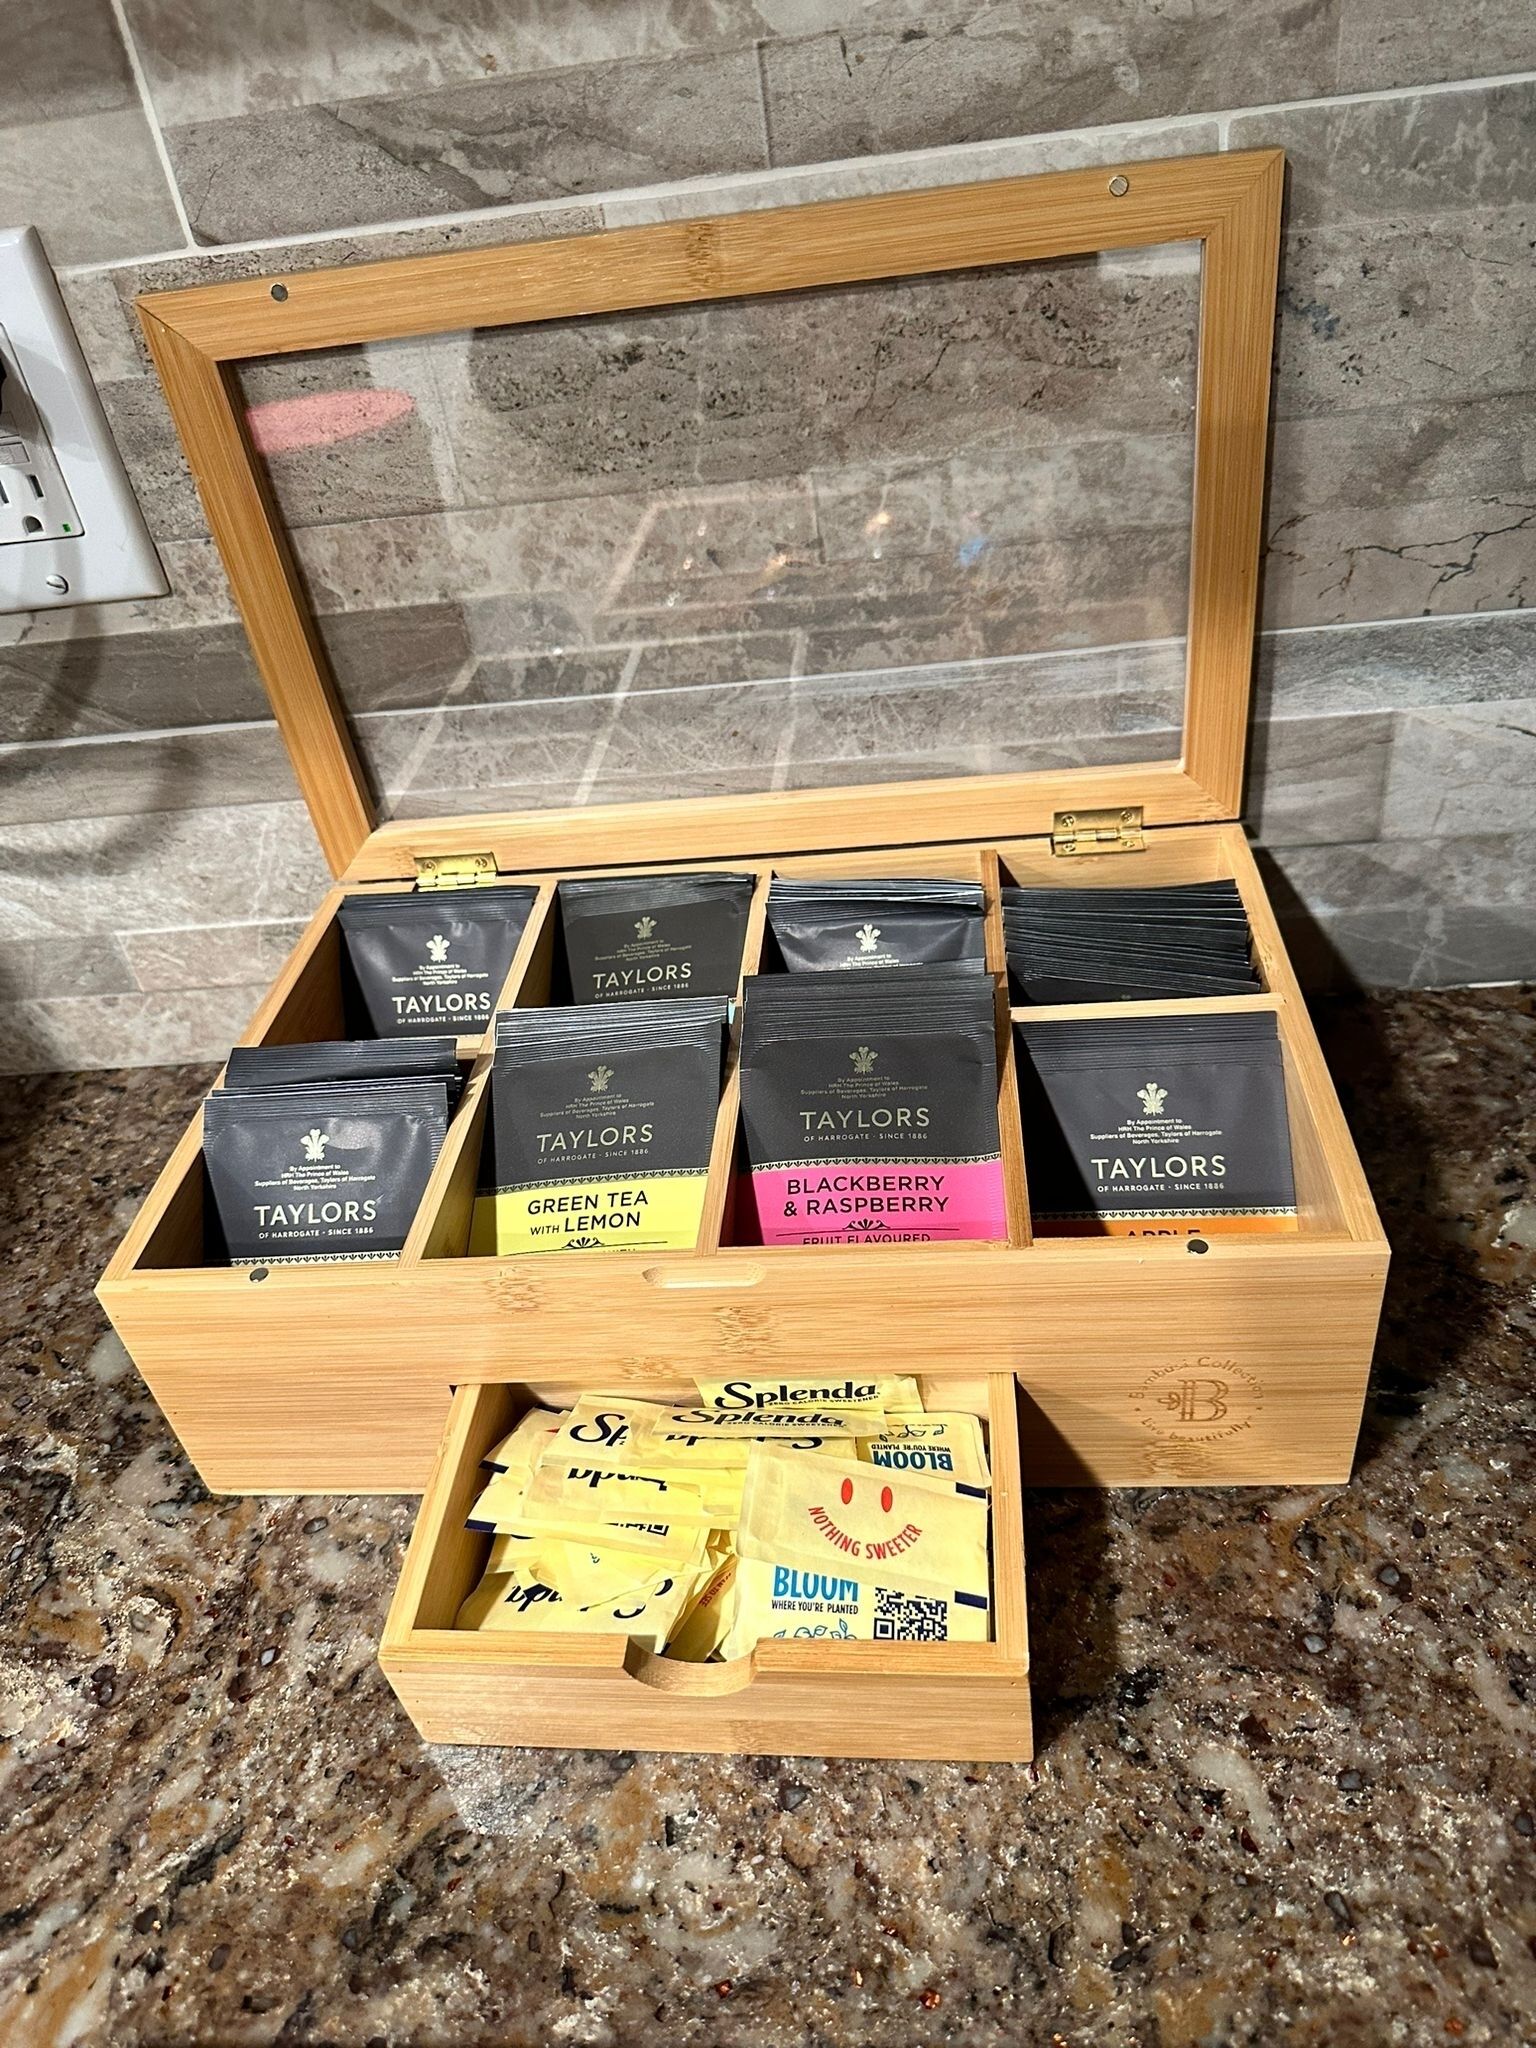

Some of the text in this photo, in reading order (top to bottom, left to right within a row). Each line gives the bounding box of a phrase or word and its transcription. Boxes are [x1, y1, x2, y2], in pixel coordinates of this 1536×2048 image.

[593, 962, 691, 989] TAYLORS
[392, 992, 491, 1013] TAYLORS
[800, 1108, 929, 1130] TAYLORS
[537, 1124, 653, 1152] TAYLORS
[550, 1153, 596, 1162] HARROGATE
[1091, 1155, 1226, 1179] TAYLORS
[787, 1175, 946, 1195] BLACKBERRY
[254, 1200, 376, 1226] TAYLORS
[527, 1190, 649, 1215] GREEN TEA
[783, 1196, 950, 1217] & RASPBERRY
[272, 1230, 320, 1238] HARROGATE
[530, 1212, 641, 1236] WITH LEMON
[1197, 1356, 1264, 1400] Collection
[714, 1381, 876, 1410] Splenda
[671, 1410, 844, 1426] Splenda
[1141, 1415, 1253, 1443] Live beautifully
[928, 1444, 951, 1453] WHERE
[872, 1450, 954, 1472] BLOOM
[808, 1506, 923, 1560] NOTHING SWEETER
[773, 1565, 859, 1602] BLOOM
[772, 1600, 859, 1615] WHERE YOU'RE PLANTED
